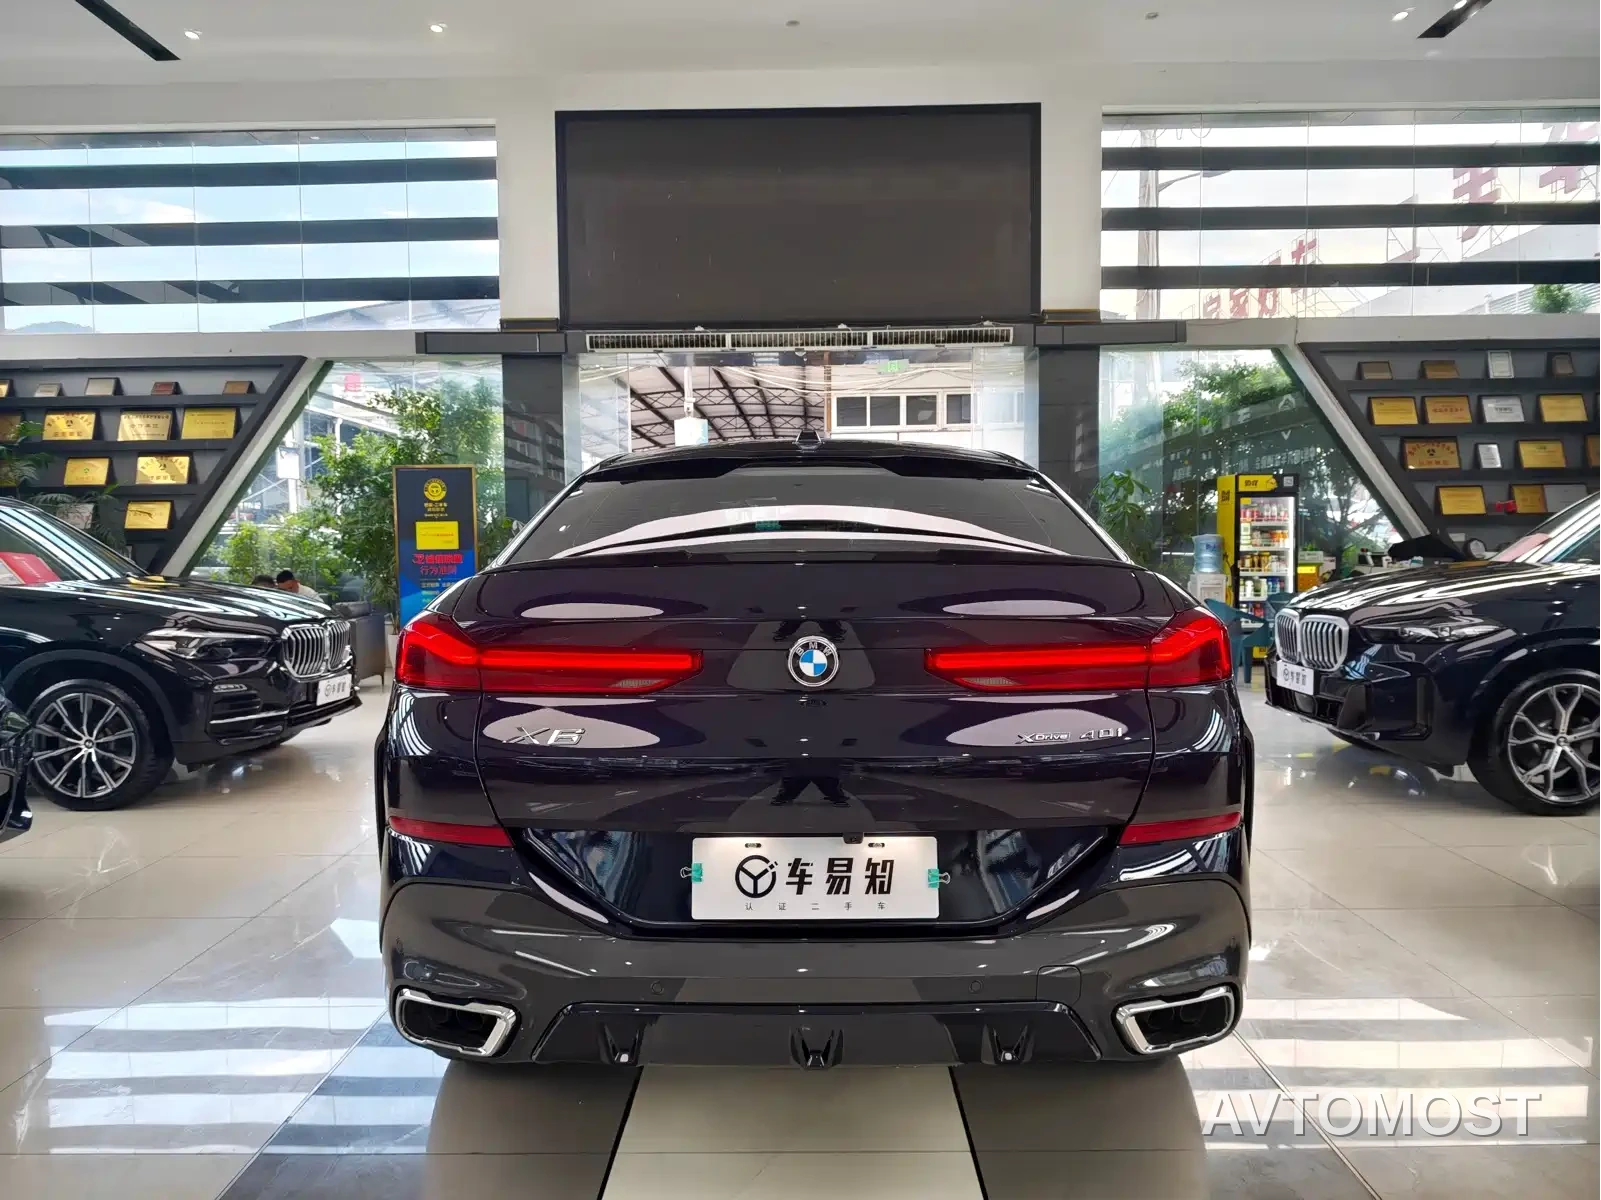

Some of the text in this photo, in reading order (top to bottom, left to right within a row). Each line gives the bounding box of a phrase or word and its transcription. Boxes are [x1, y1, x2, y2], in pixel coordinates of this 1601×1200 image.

[795, 641, 833, 656] BMW
[502, 724, 586, 746] X6
[785, 857, 894, 895] 车易知
[745, 902, 886, 911] 认证二手车
